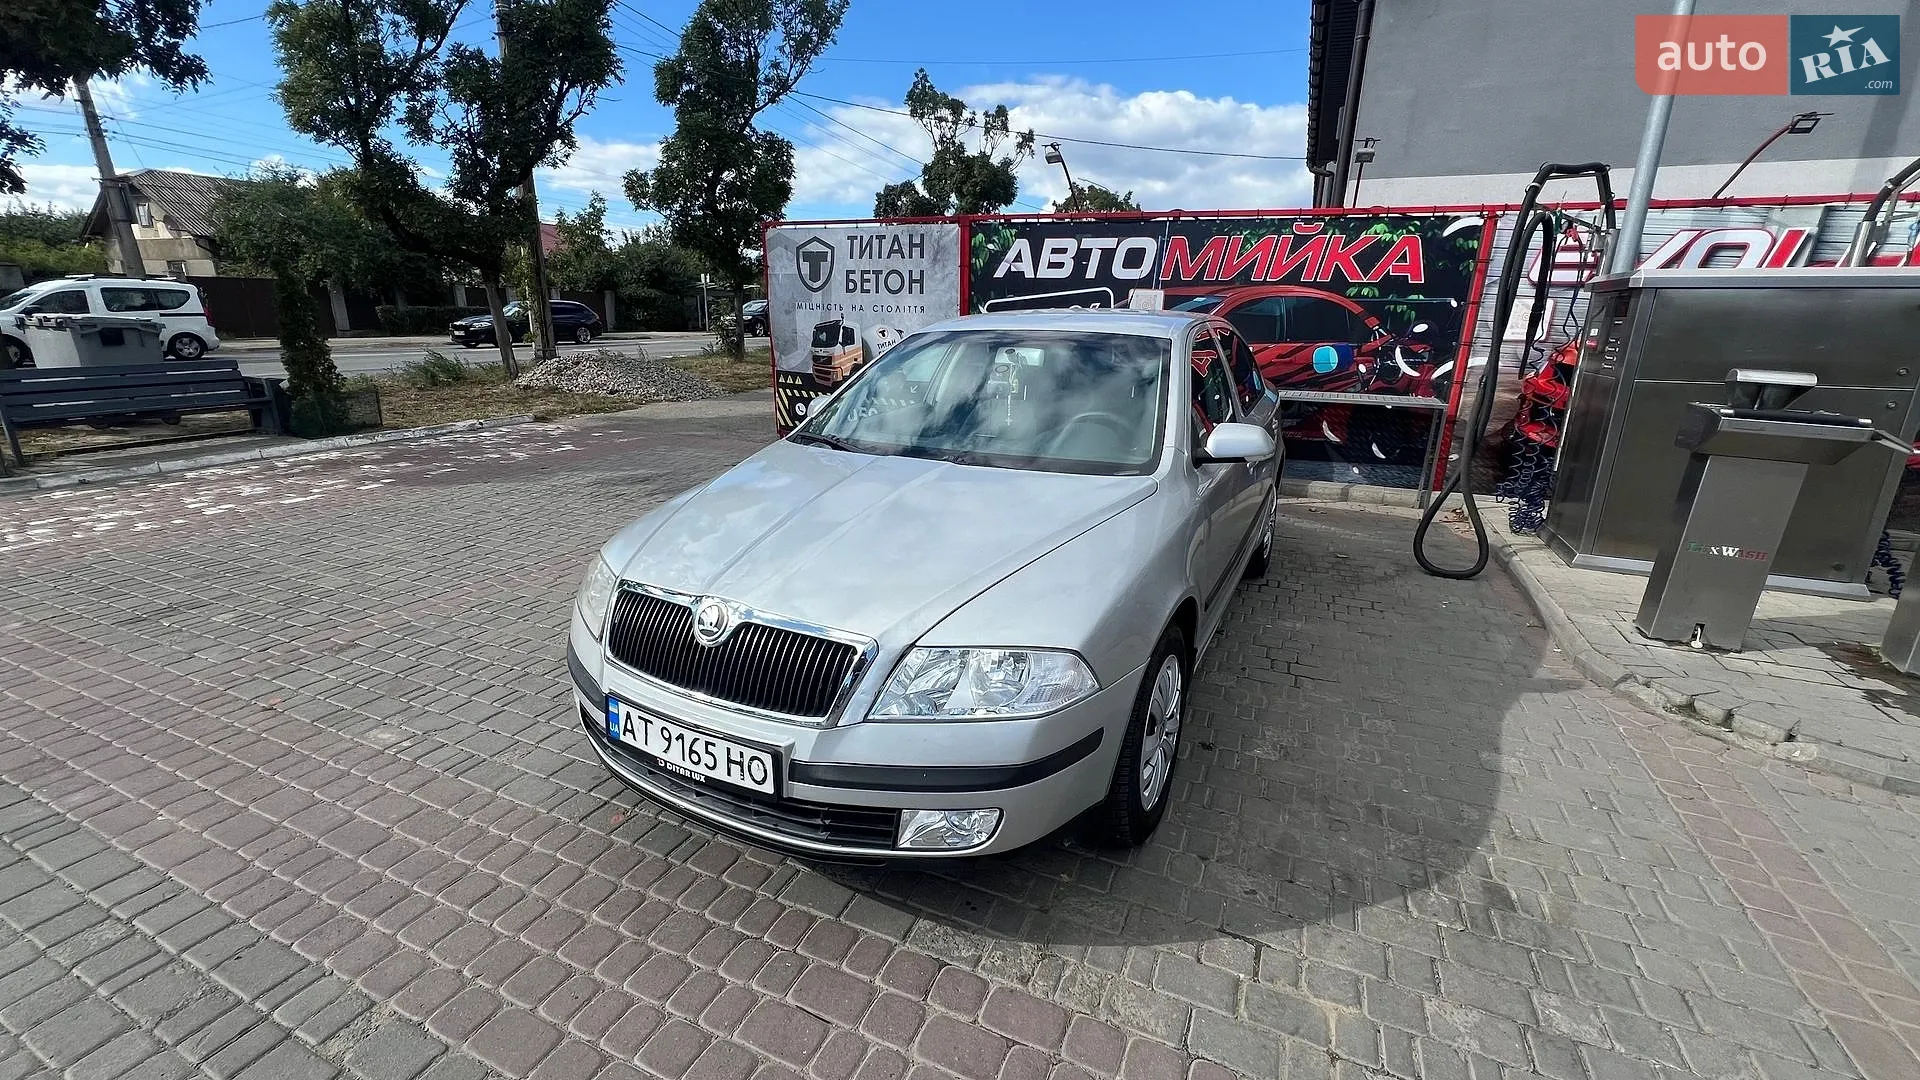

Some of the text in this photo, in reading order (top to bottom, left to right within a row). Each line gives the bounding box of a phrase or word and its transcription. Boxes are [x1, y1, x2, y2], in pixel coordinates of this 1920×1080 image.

[847, 234, 925, 260] ТИТАН
[845, 269, 925, 295] БЕТОН
[796, 302, 925, 314] МІЦНІСТЬ НА СТОЛІТТЯ
[609, 721, 620, 734] UA
[622, 711, 768, 785] AT 9165 HO
